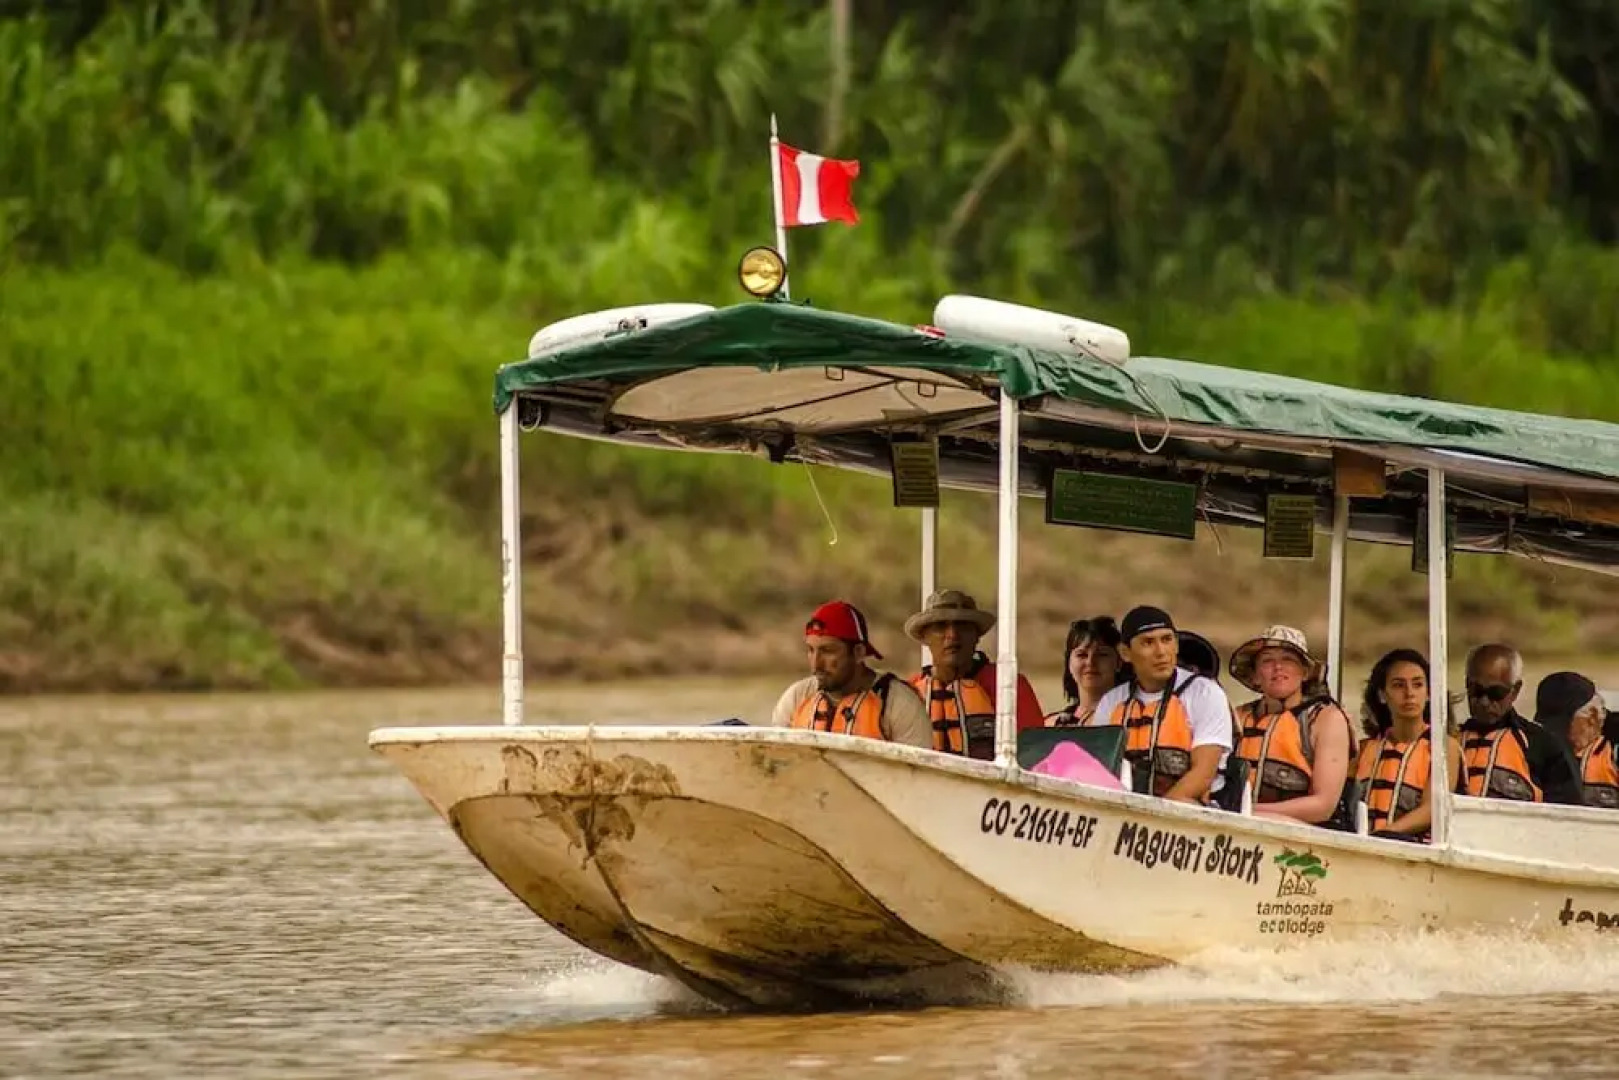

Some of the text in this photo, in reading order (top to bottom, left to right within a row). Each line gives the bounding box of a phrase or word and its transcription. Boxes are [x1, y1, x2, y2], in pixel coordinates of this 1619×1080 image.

[980, 797, 1098, 848] CO-21614-BF
[1113, 822, 1264, 885] Maguari Stork
[1257, 901, 1334, 918] tambopata
[1259, 918, 1325, 938] ecolodge
